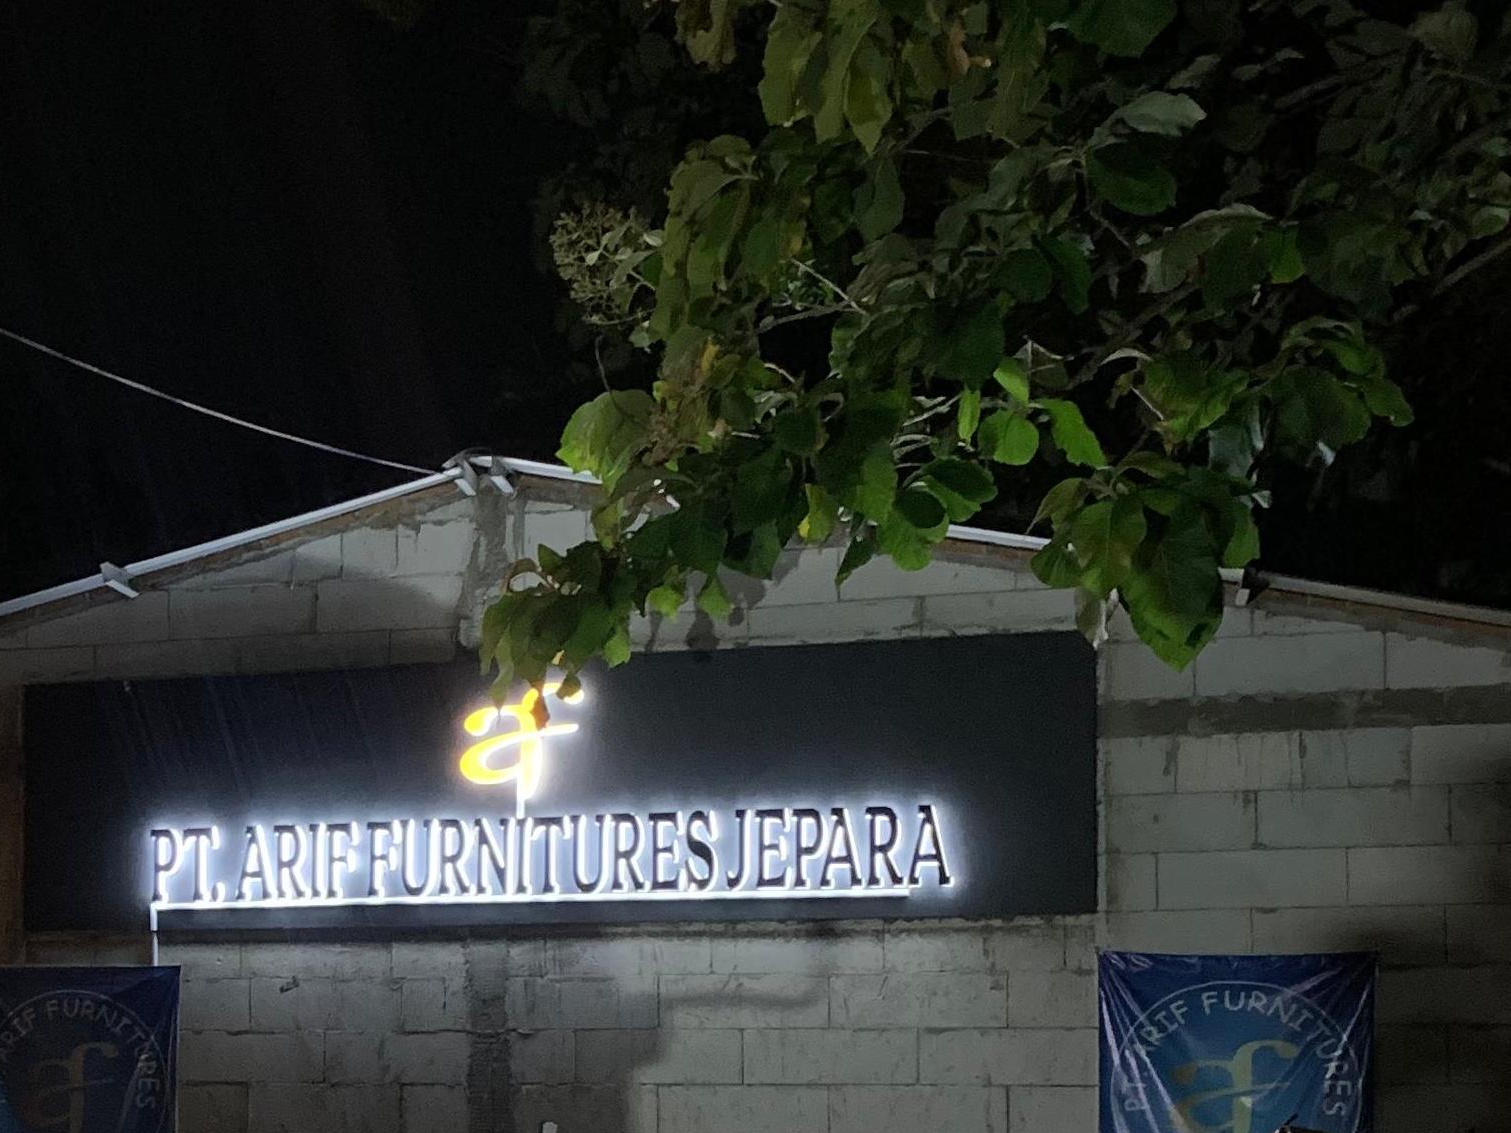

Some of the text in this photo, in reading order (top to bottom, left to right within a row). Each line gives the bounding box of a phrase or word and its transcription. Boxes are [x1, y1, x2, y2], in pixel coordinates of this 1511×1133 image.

[150, 804, 955, 904] PT. ARIF FURNITURES JEPARA
